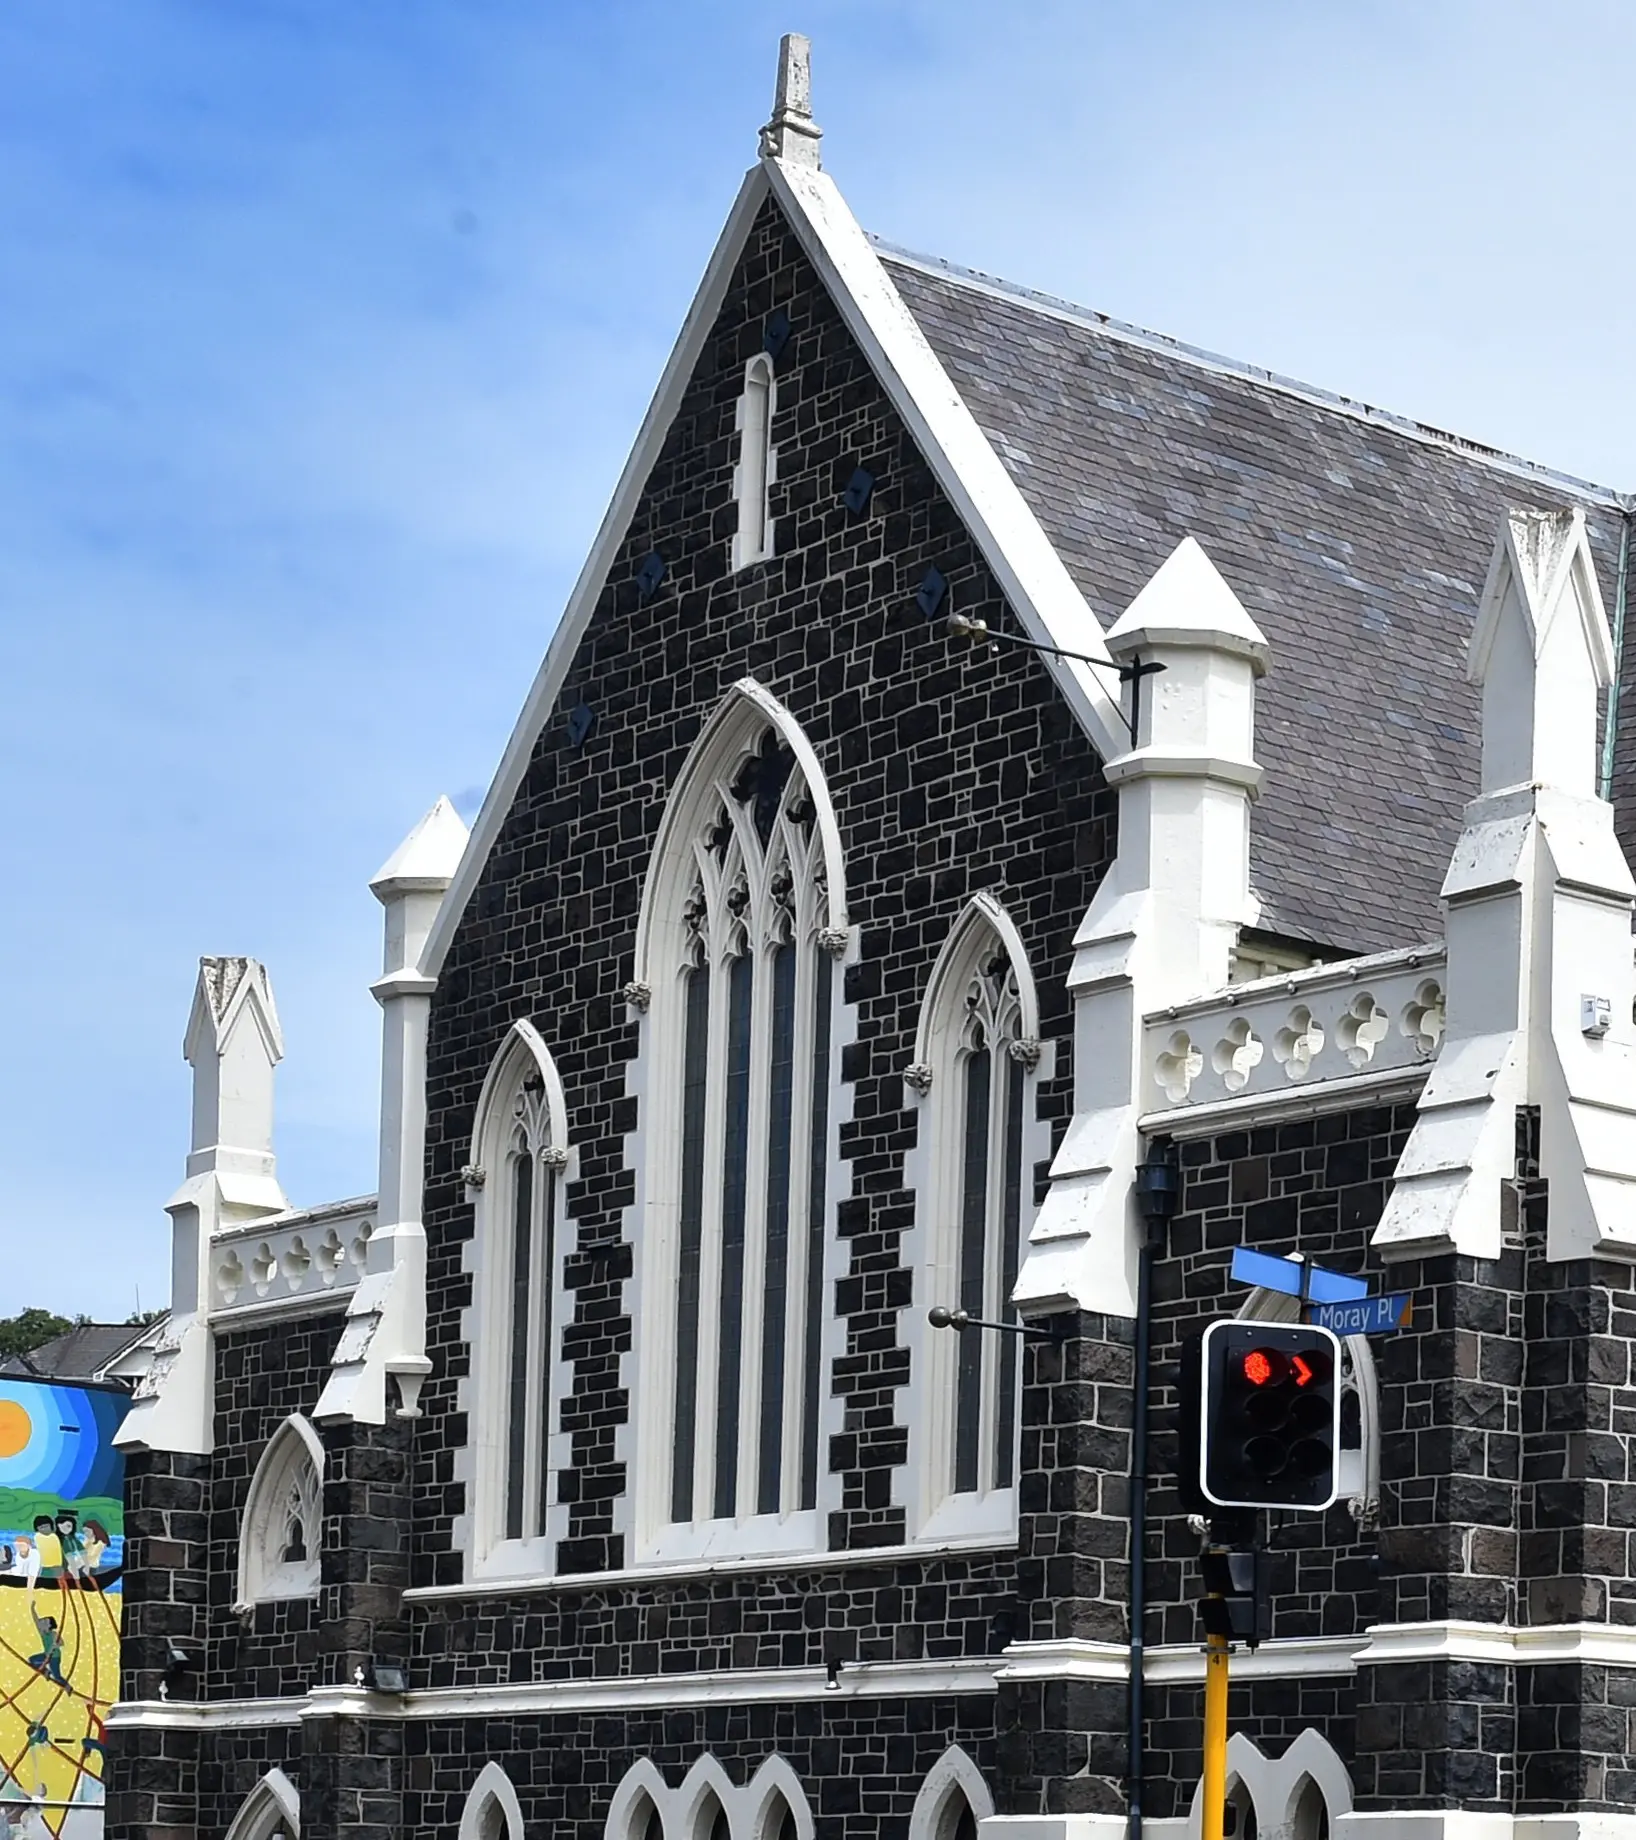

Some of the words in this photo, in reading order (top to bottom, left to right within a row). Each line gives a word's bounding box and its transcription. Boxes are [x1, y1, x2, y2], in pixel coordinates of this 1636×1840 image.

[1320, 1305, 1370, 1332] Moray
[1377, 1297, 1393, 1324] Pl
[1212, 1654, 1220, 1665] 4
